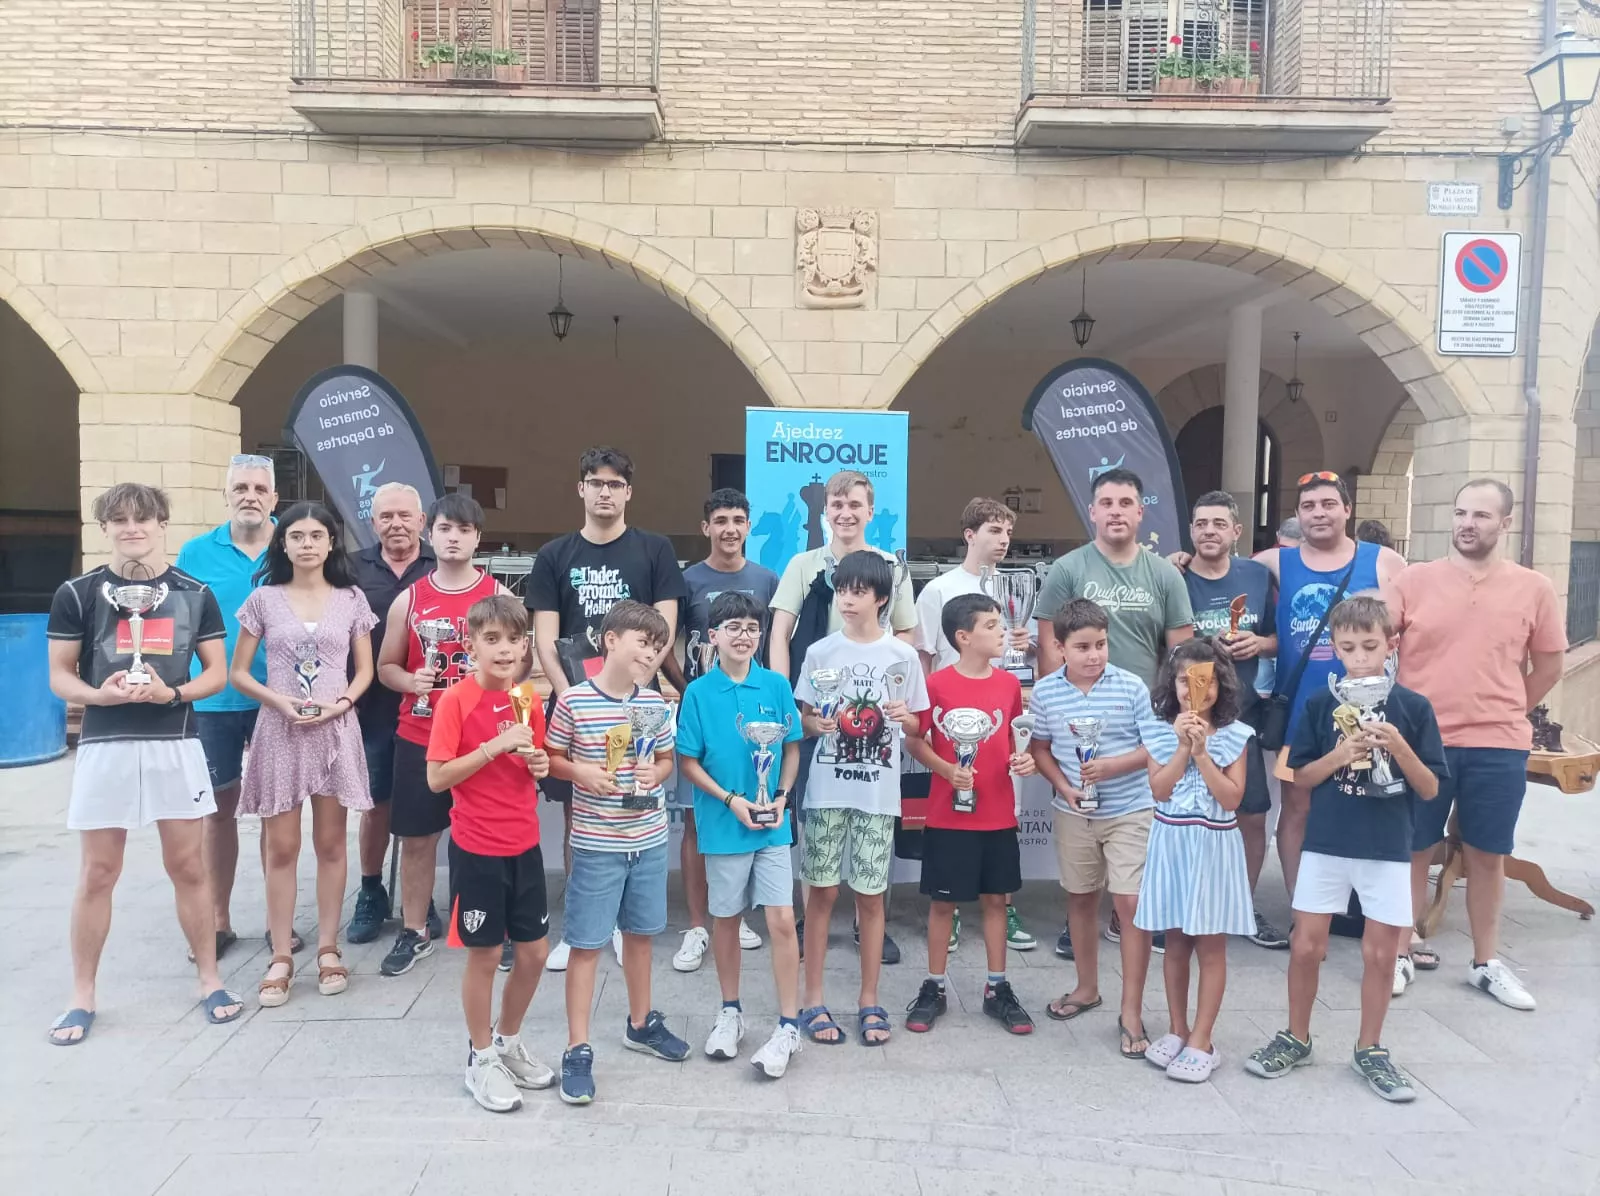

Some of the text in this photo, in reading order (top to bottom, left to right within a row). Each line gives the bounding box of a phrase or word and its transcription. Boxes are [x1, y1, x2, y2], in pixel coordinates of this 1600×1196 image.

[772, 421, 844, 442] Ajedrez
[766, 441, 888, 466] ENROQUE
[580, 565, 620, 585] Under
[578, 579, 623, 605] ground
